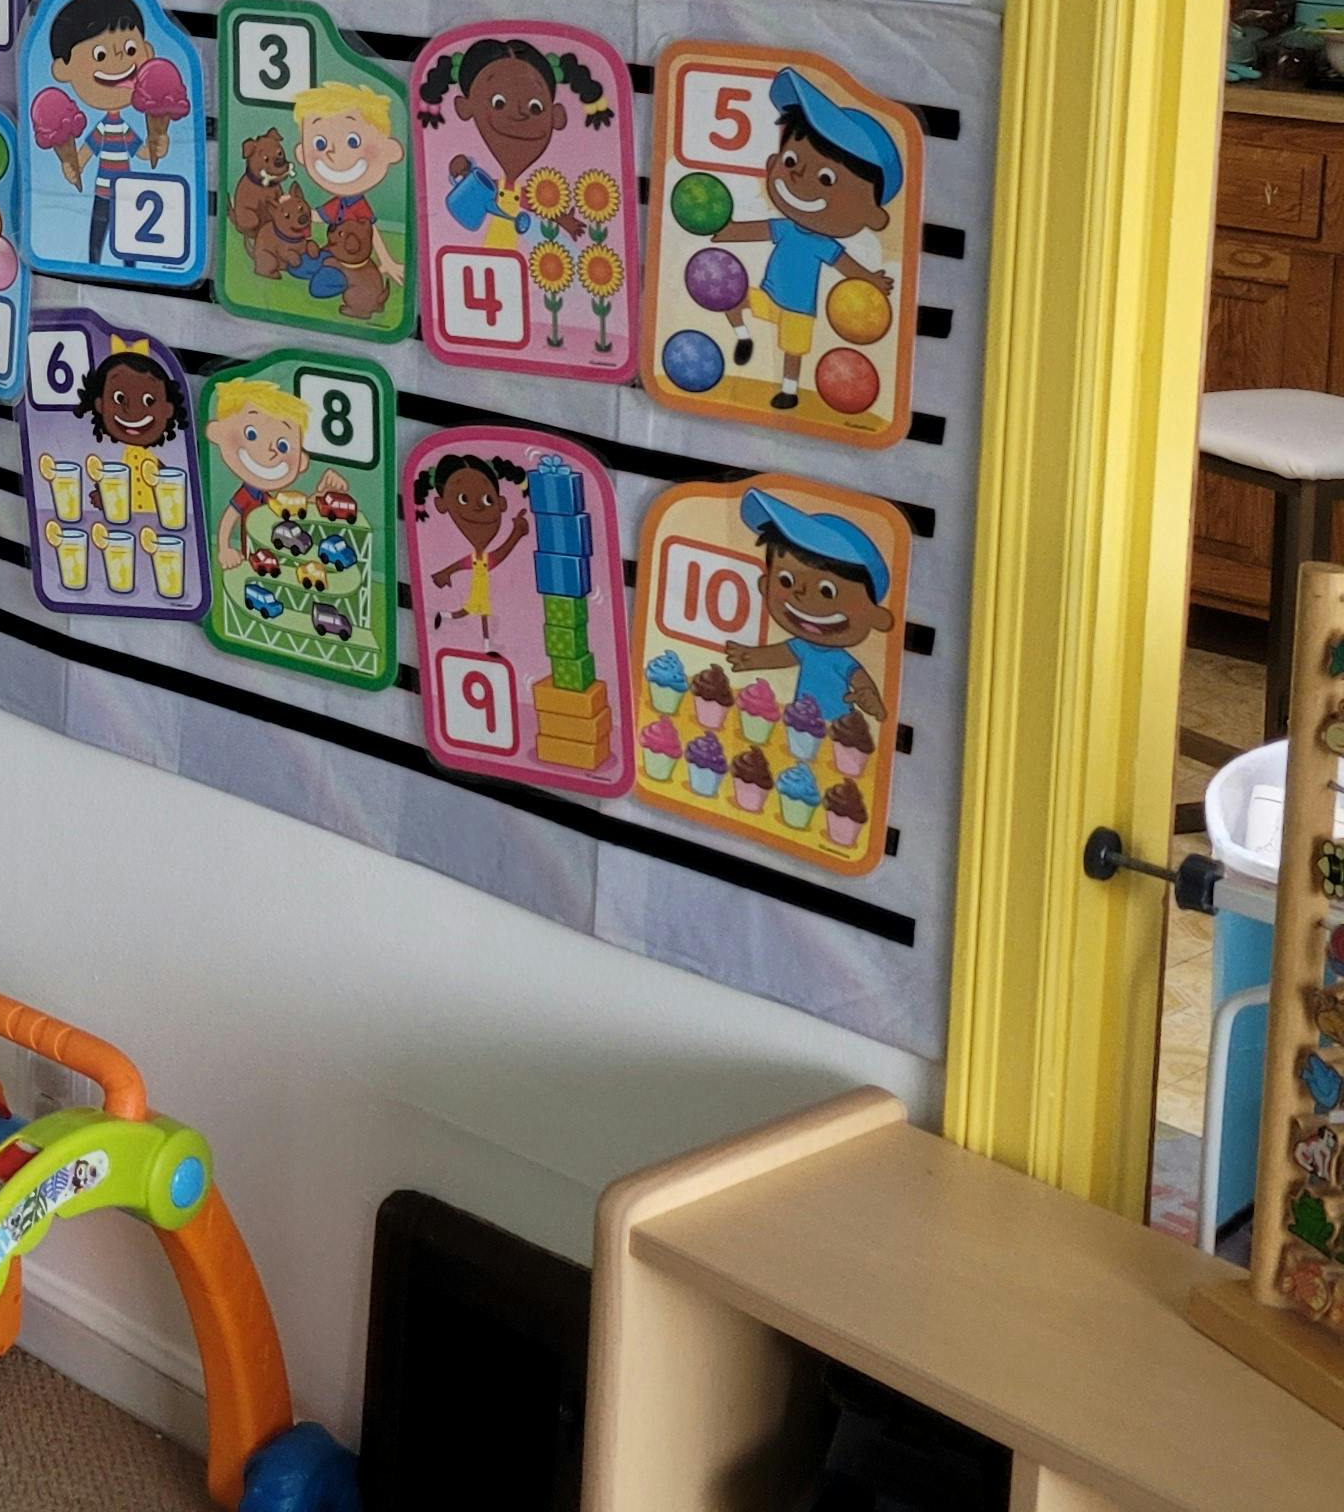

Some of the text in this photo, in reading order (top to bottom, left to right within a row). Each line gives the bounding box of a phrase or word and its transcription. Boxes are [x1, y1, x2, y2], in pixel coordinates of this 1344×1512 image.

[258, 33, 291, 90] 3
[708, 86, 753, 151] 5
[134, 189, 165, 244] 2
[462, 265, 503, 327] 4
[46, 341, 75, 394] 6
[321, 389, 354, 447] 8
[683, 561, 751, 634] 10
[461, 670, 497, 734] 9
